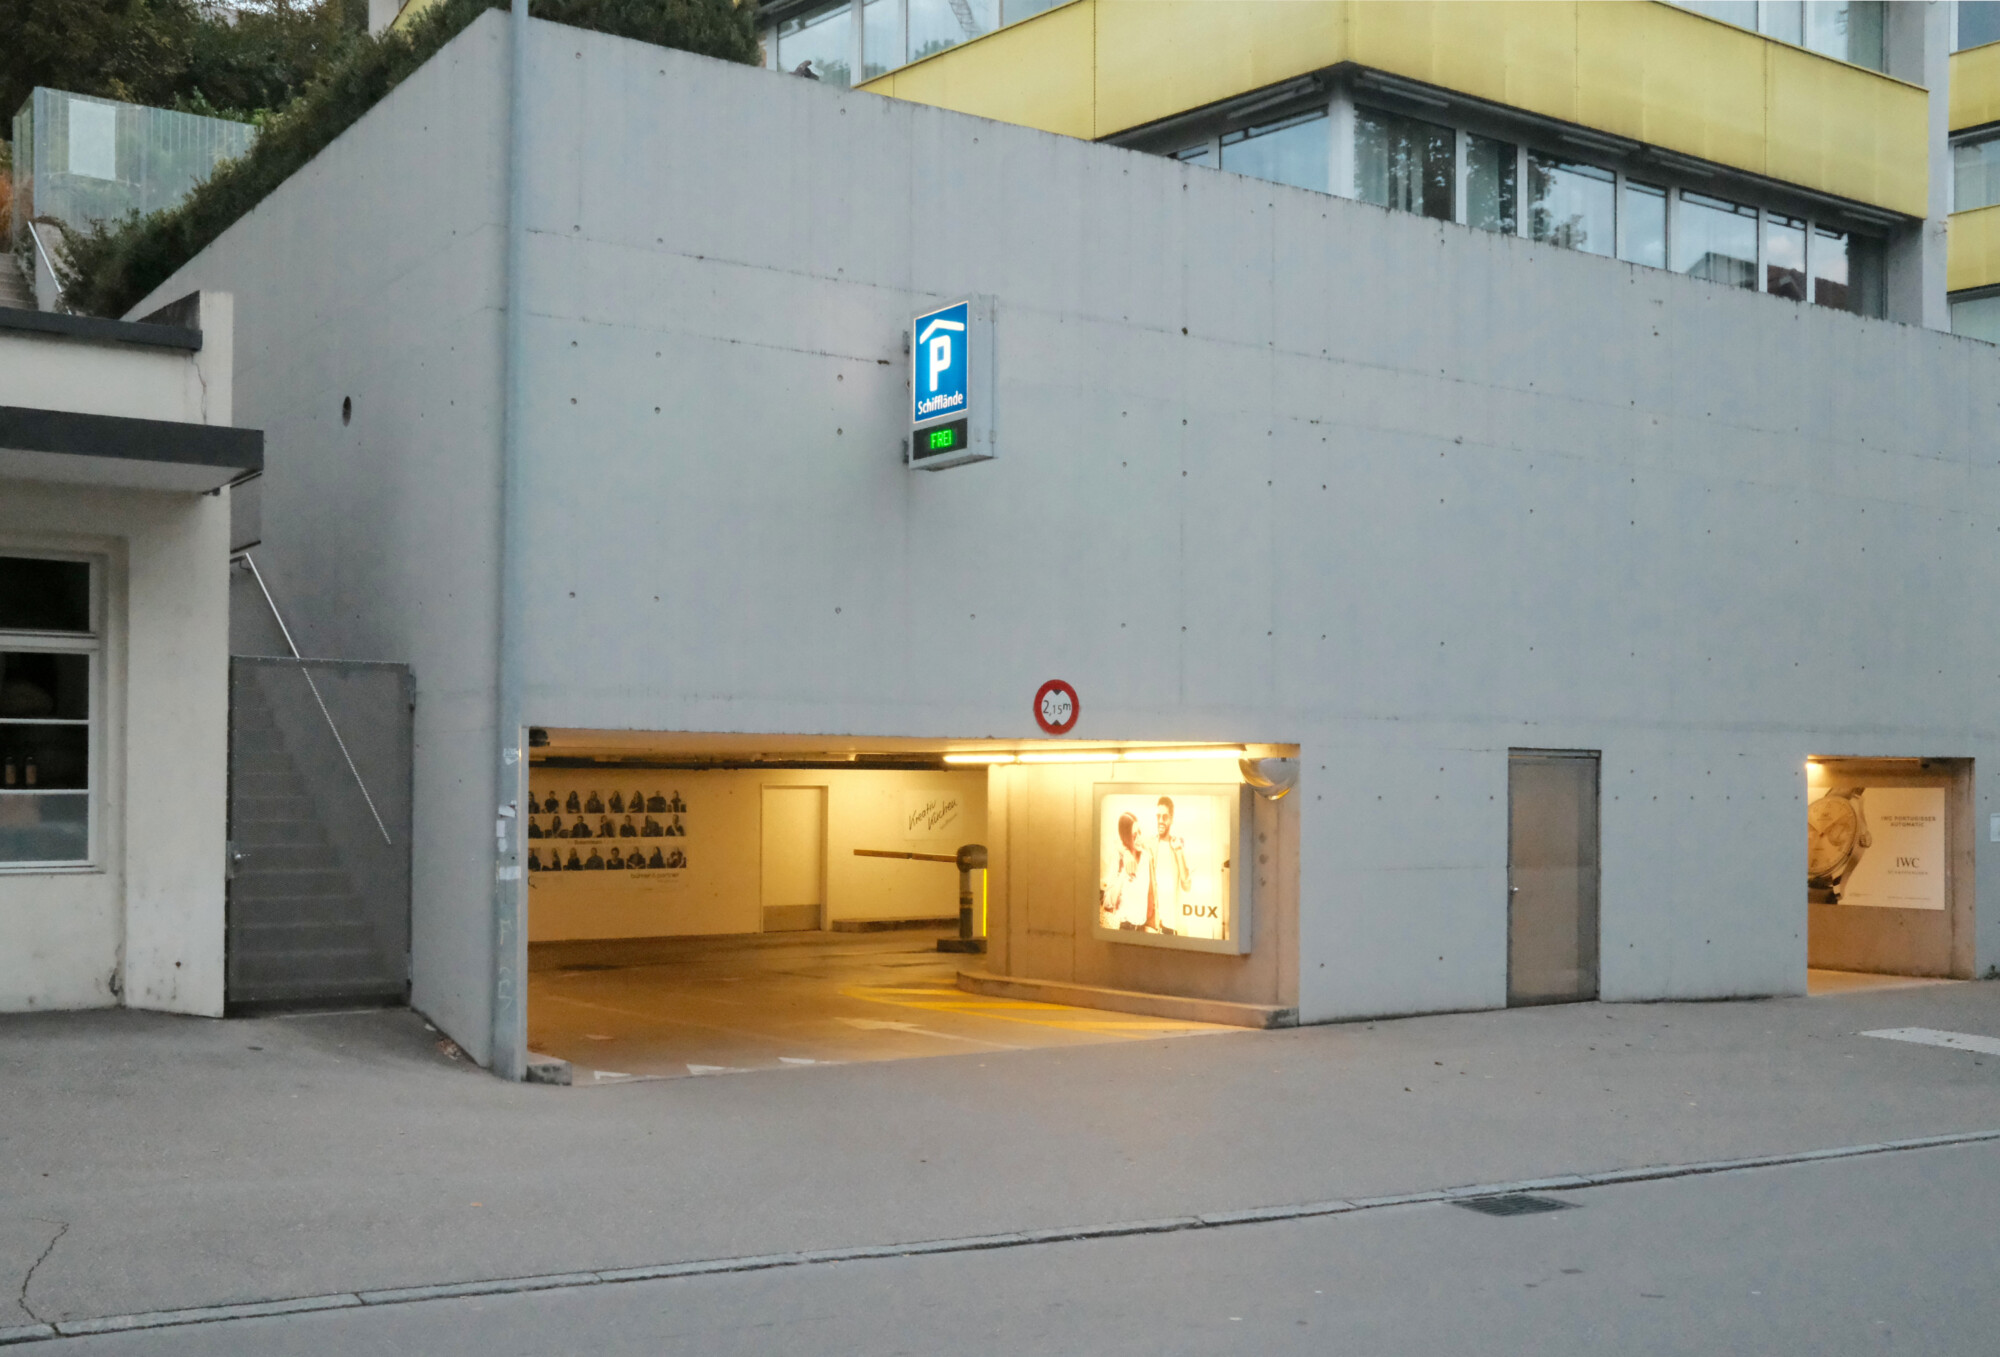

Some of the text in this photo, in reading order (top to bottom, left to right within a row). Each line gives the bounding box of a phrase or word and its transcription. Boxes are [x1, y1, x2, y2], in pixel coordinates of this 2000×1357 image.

[929, 334, 951, 392] P
[917, 390, 964, 415] Schifflände
[930, 429, 953, 449] FREI
[1896, 856, 1920, 868] IWC
[1182, 903, 1218, 919] DUX
